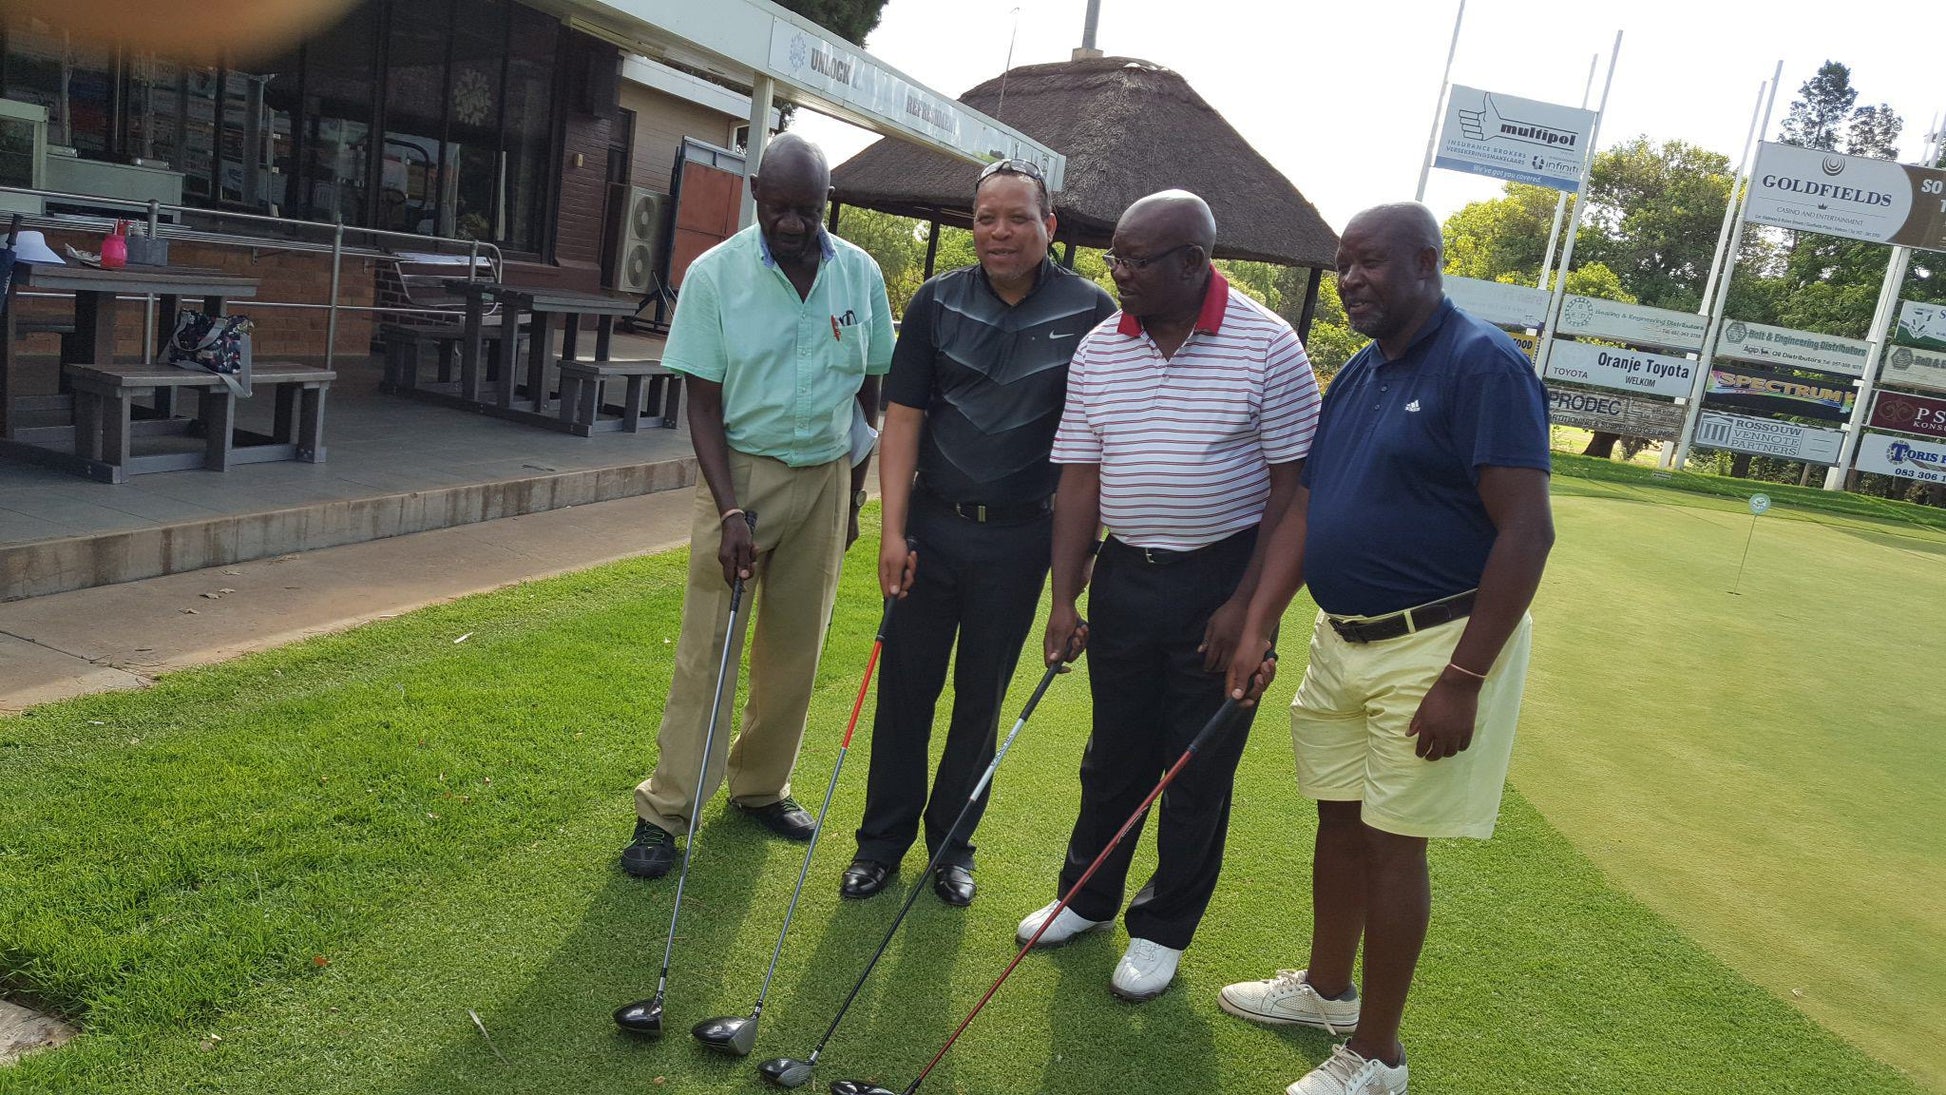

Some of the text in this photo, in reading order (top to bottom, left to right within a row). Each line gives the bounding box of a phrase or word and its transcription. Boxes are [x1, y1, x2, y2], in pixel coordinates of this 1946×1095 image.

[810, 48, 851, 85] UNLOCK
[1500, 124, 1577, 146] multipol
[1448, 140, 1527, 158] INSURANCE BROKERS
[1762, 175, 1892, 207] GOLDFIELDS
[1777, 206, 1800, 216] CASINO
[1802, 210, 1815, 218] AND
[1815, 212, 1864, 226] ENTERTAINMENT
[1666, 319, 1705, 331] Distributors
[1748, 330, 1766, 340] Bolt
[1766, 333, 1772, 341] &
[1773, 333, 1819, 350] Engineering
[1819, 339, 1867, 357] Distributors
[1598, 352, 1690, 379] Oranje Toyota
[1782, 353, 1822, 364] Distributors
[1553, 366, 1588, 379] TOYOTA
[1625, 375, 1656, 388] WELKOM
[1718, 372, 1842, 403] SPECTRUM
[1736, 419, 1803, 436] ROSSOUW
[1734, 430, 1800, 447] VENNOTE
[1731, 440, 1798, 456] PARTNERS
[1895, 468, 1915, 477] 083
[1918, 471, 1938, 480] 306
